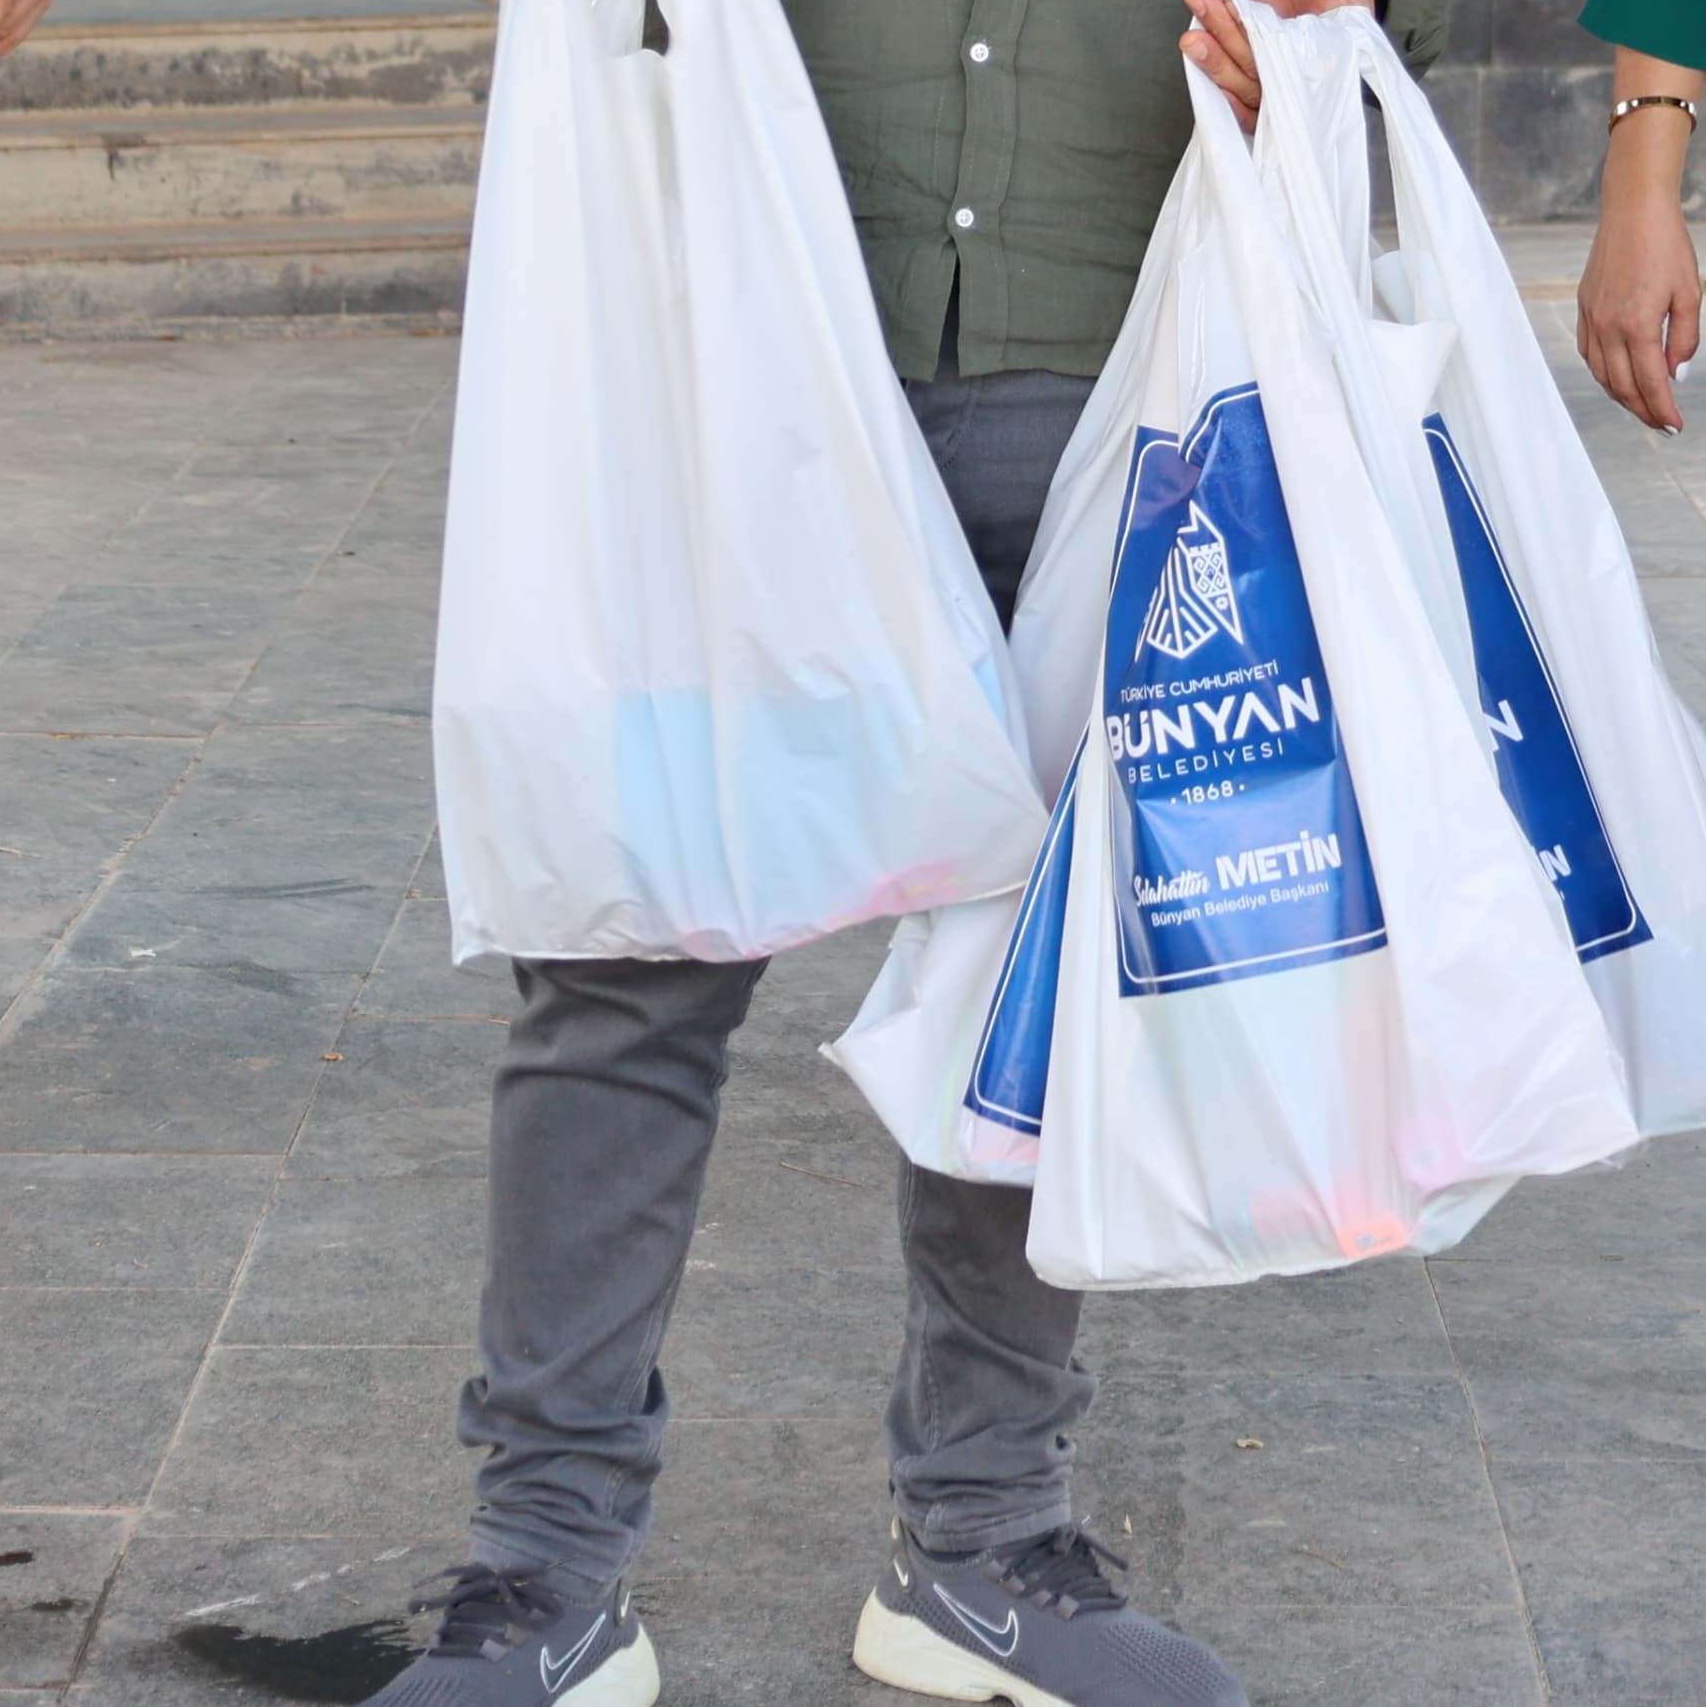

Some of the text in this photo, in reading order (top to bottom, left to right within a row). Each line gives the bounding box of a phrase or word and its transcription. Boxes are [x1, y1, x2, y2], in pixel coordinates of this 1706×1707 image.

[1121, 659, 1279, 703] TÜRKİYE CUMHURİYETİ
[1107, 677, 1320, 761] BÜNYAN
[1128, 738, 1284, 784] BELEDİYESİ
[1215, 830, 1342, 890] METİN
[1151, 881, 1330, 927] Bünyan Belediye Başkanı
